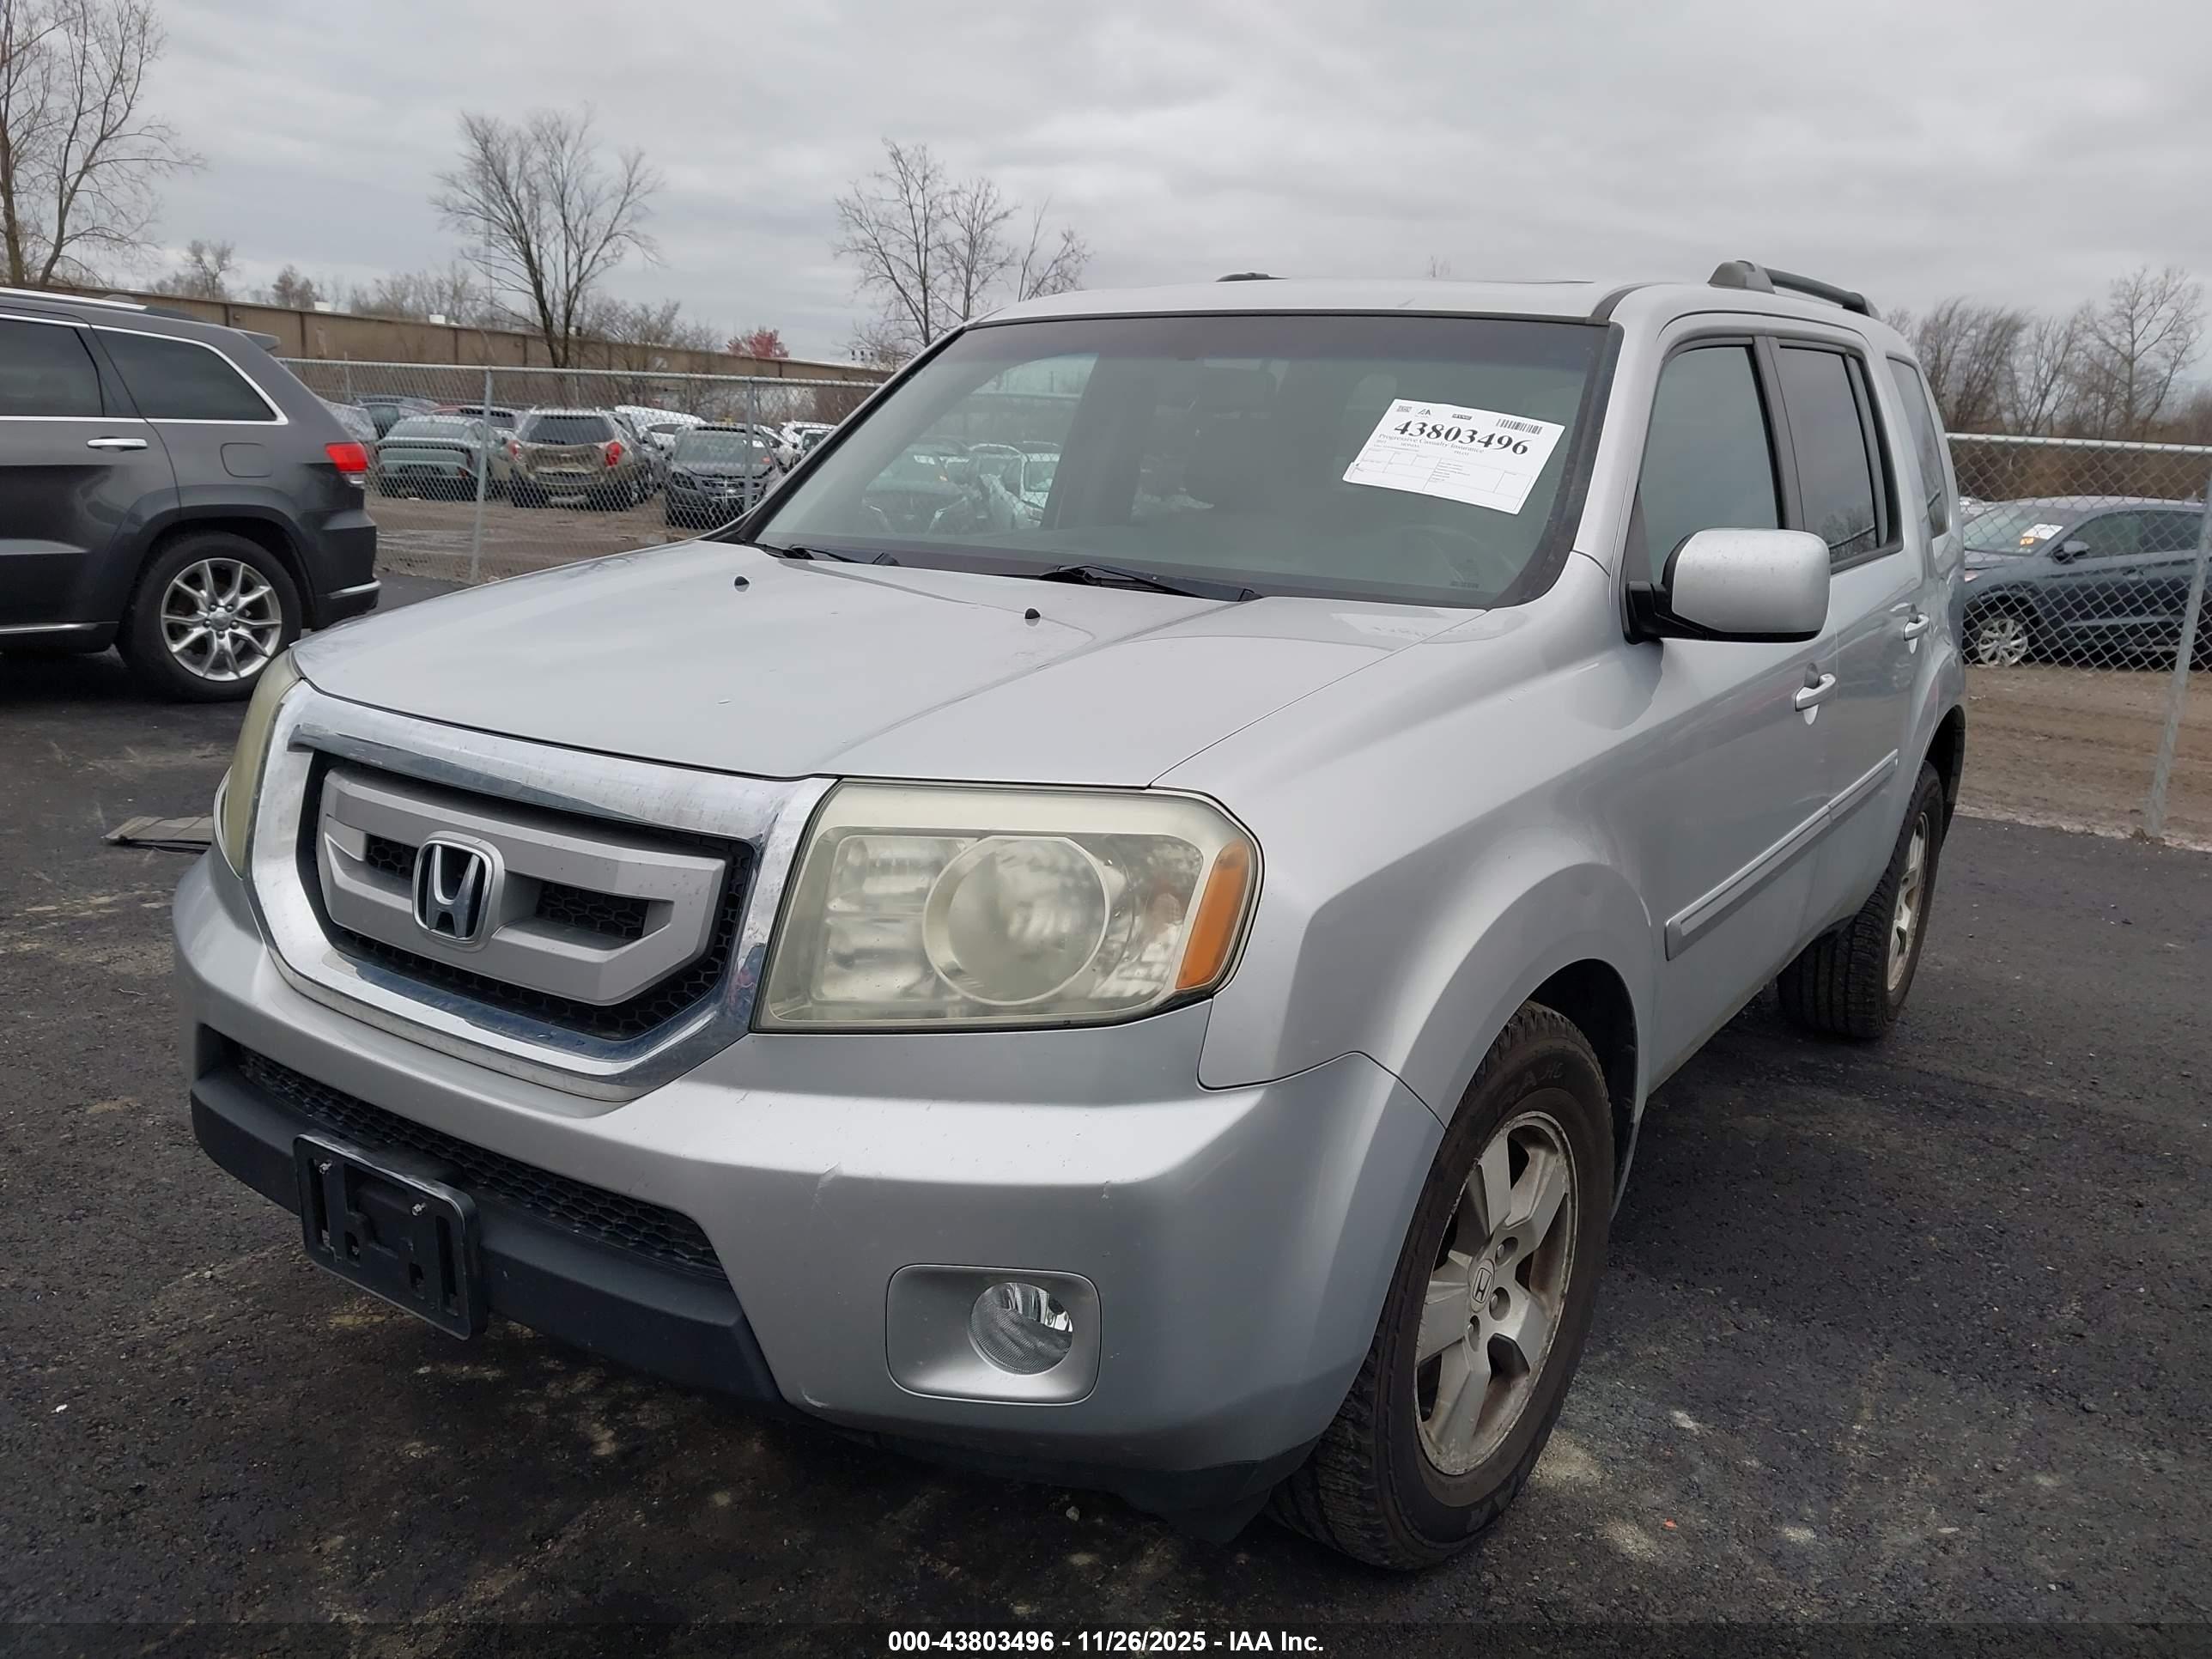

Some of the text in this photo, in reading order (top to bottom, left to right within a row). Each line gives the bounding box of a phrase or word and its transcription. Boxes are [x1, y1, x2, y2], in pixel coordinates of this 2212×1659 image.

[1378, 434, 1419, 443] Progressive
[1419, 438, 1448, 447] Casualty
[1450, 442, 1485, 453] Insurance
[1395, 420, 1532, 455] 43803496
